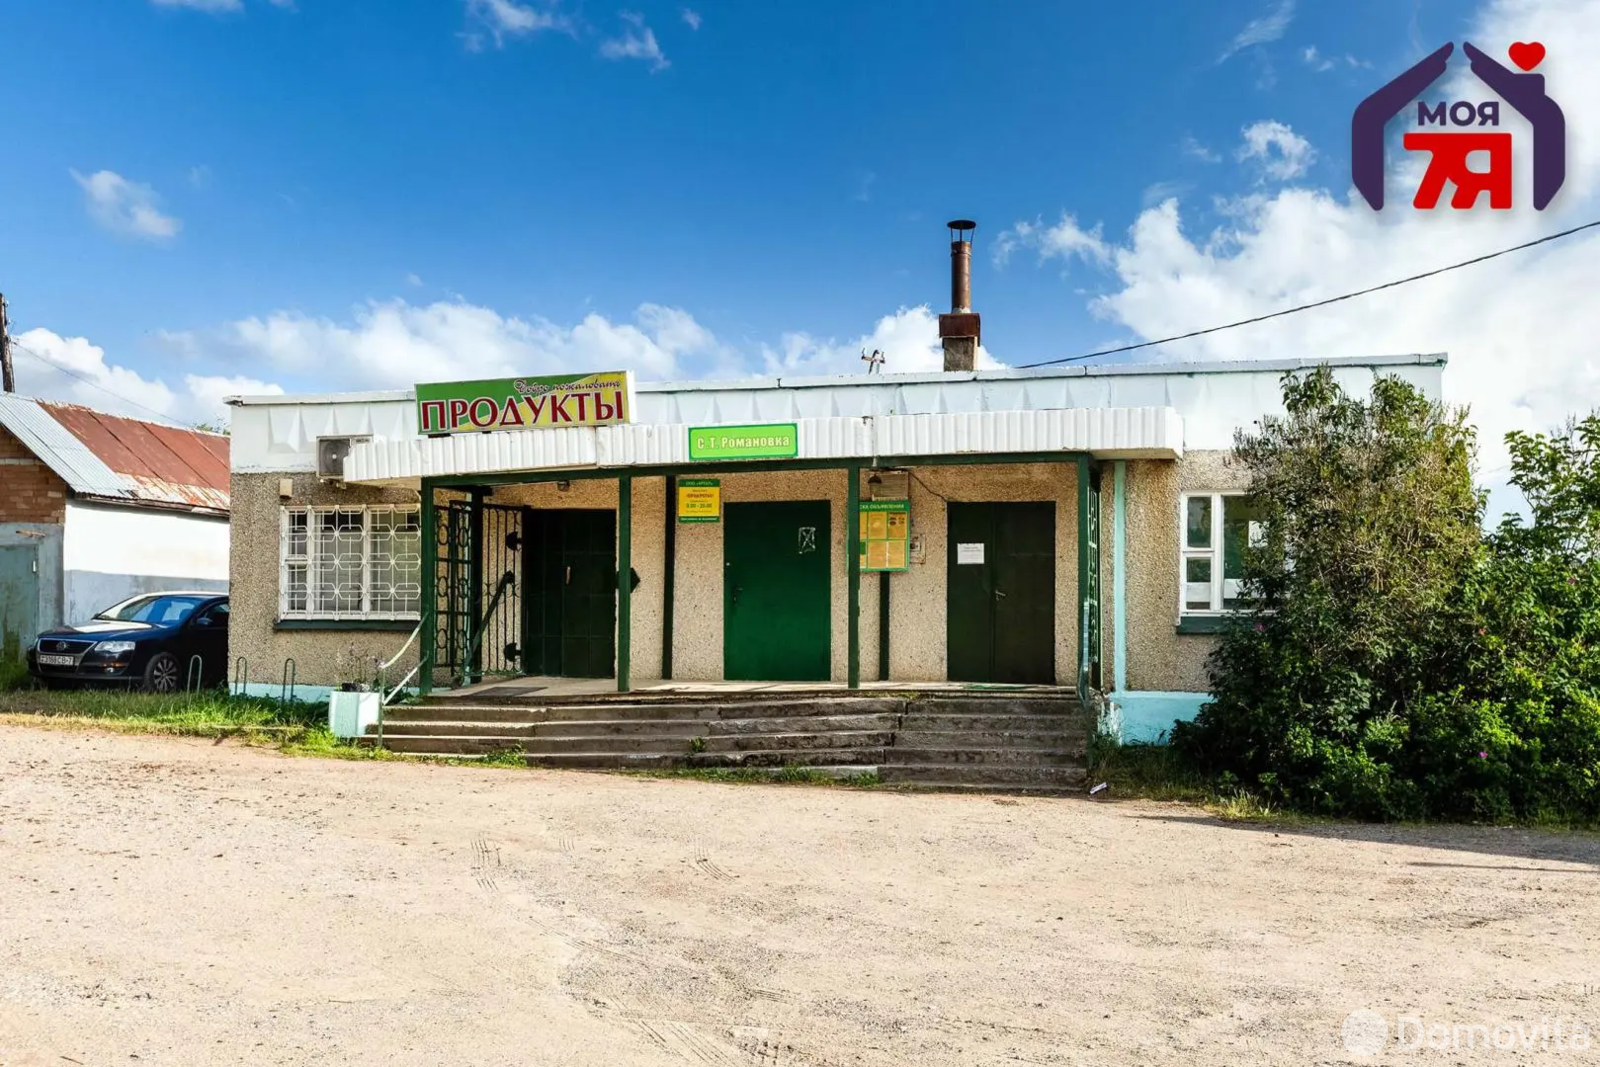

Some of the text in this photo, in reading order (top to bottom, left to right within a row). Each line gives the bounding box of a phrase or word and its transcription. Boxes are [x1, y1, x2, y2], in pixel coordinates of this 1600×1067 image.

[513, 378, 621, 395] Добро пожаловать
[420, 391, 625, 431] ПРОДУКТЫ
[721, 436, 790, 448] Романовка
